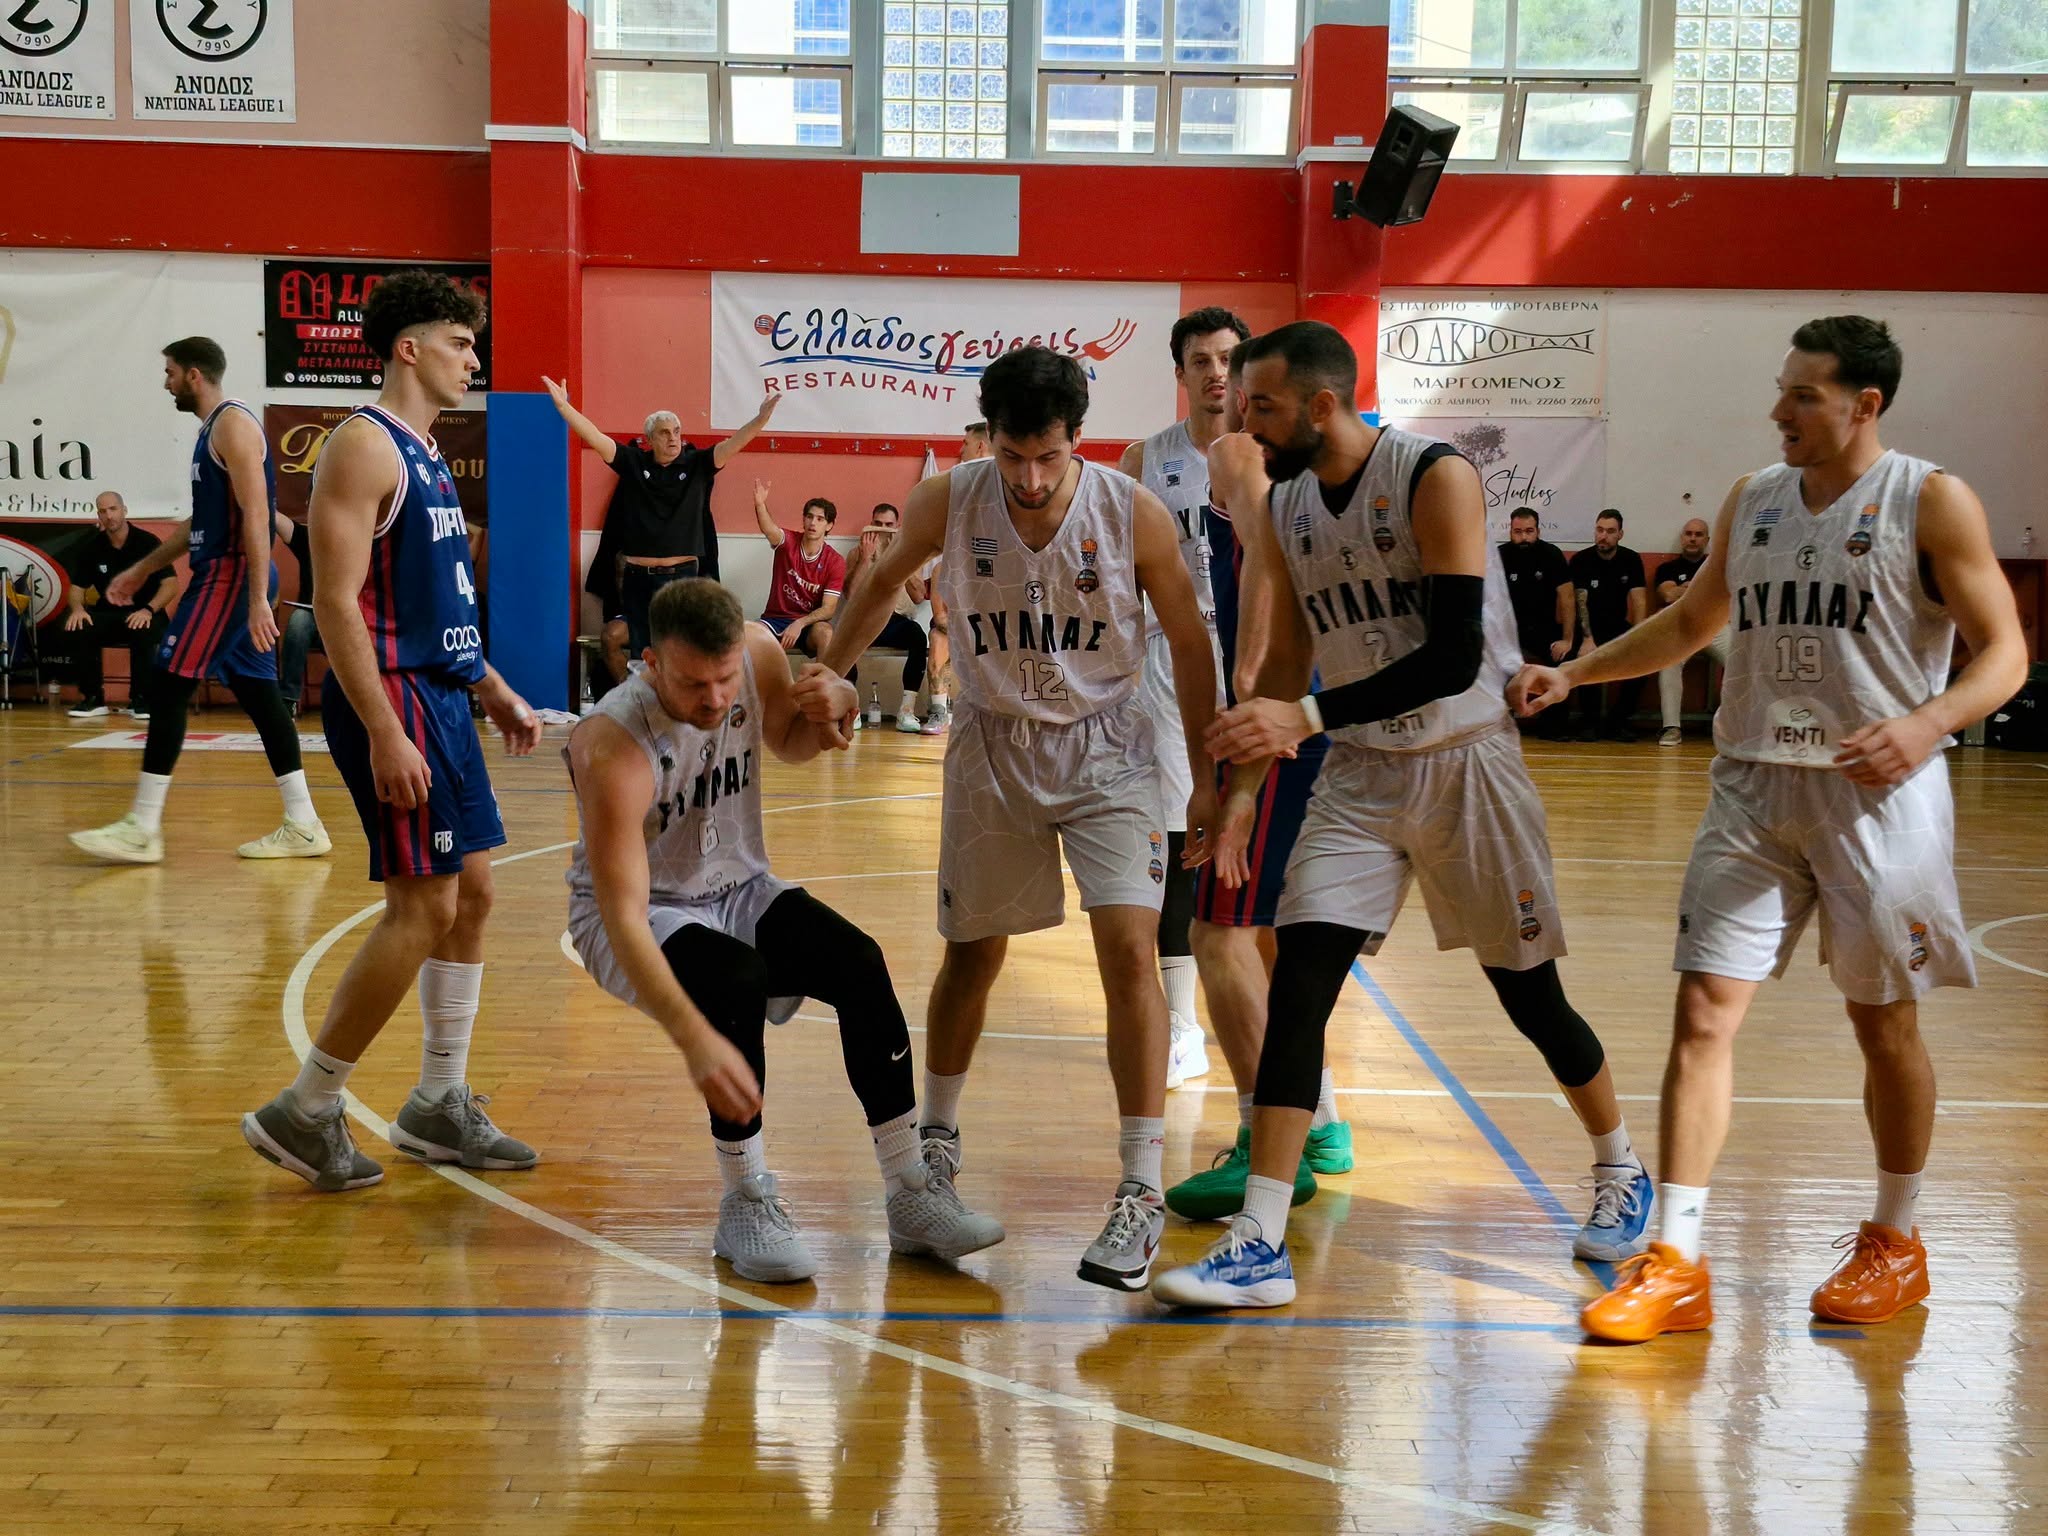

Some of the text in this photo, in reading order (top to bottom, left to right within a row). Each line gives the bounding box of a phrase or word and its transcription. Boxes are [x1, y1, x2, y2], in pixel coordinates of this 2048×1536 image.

[16, 33, 51, 46] 1990
[196, 39, 231, 52] 1990
[174, 75, 253, 95] ΑΝΟΔΟΣ
[37, 93, 93, 109] LEAGUE
[96, 95, 106, 109] 2
[145, 96, 284, 112] NATIONAL LEAGUE 1
[310, 326, 363, 338] ΓΙΩΡΓ
[303, 342, 373, 353] ΣΥΣΤΗΜΑ
[298, 374, 362, 384] 690 6578515
[764, 371, 956, 402] RESTAURANT
[1413, 377, 1566, 389] ΜΑΡΓΩΜΕΝΟΣ
[1485, 464, 1558, 507] Studios
[30, 492, 94, 513] bistro
[456, 562, 475, 605] 4
[1738, 581, 1873, 634] ΣΥΛΛΑΣ
[967, 610, 1107, 657] ΣΥΛΛΑΣ
[1776, 635, 1823, 682] 19
[1019, 658, 1068, 701] 12
[1774, 726, 1825, 745] VENTI
